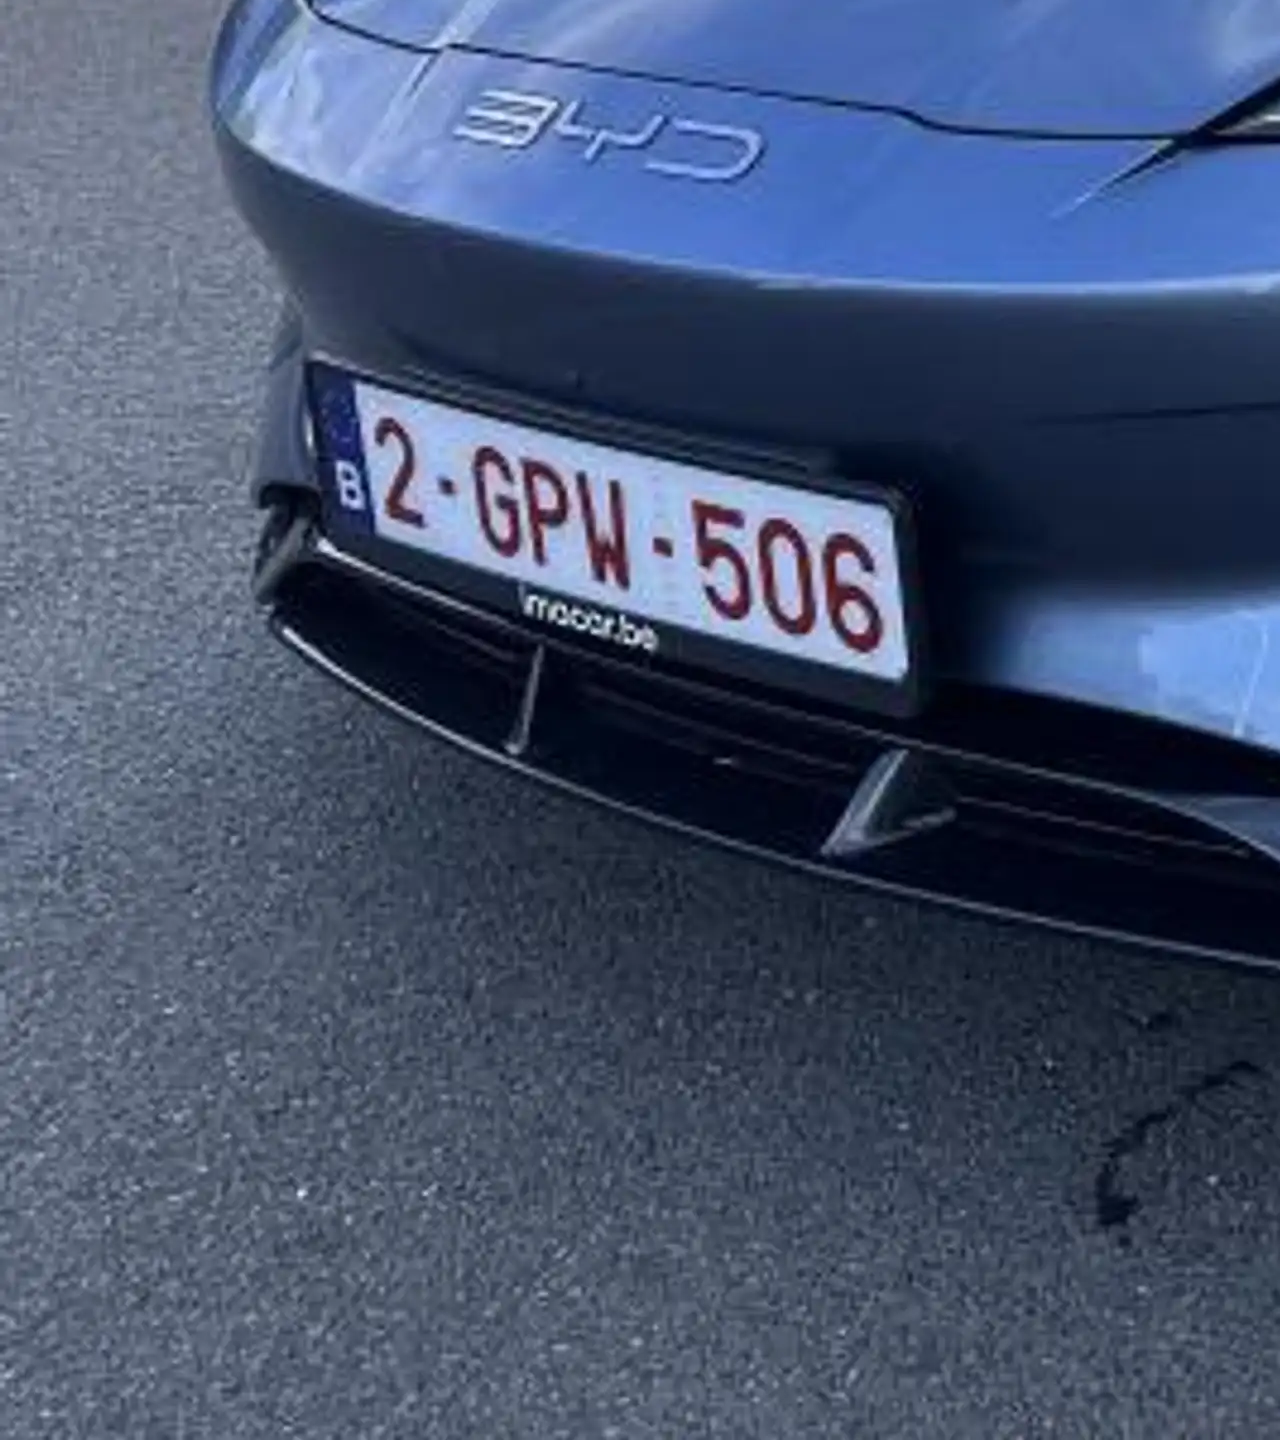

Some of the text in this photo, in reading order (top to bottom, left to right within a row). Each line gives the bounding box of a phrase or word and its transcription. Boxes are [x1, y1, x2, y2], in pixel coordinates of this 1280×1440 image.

[453, 89, 766, 182] BYD
[335, 459, 365, 511] B
[373, 417, 885, 654] 2-GPW-506
